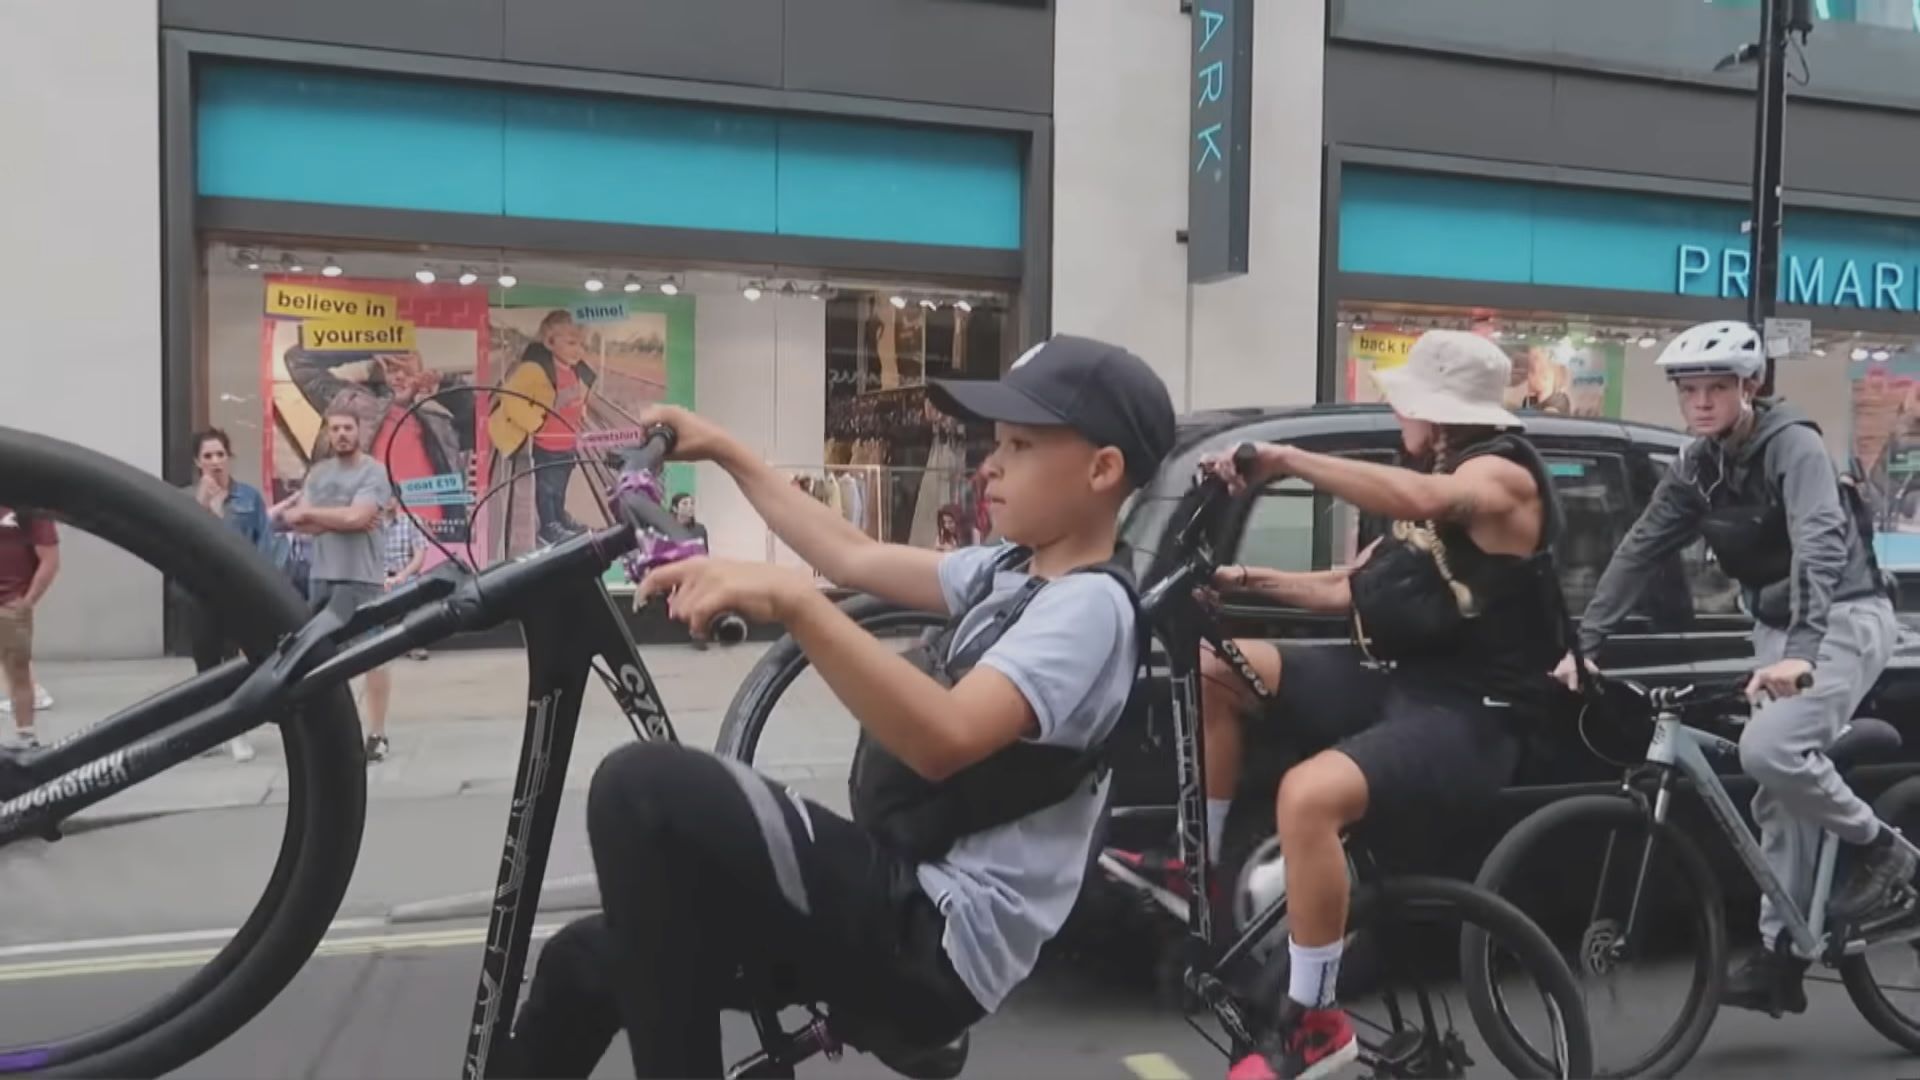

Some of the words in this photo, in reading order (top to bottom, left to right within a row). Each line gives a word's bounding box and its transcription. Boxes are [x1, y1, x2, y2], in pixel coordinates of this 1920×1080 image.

[1678, 244, 1920, 311] PRMAR
[278, 290, 358, 315] believe
[366, 297, 385, 318] in
[576, 304, 624, 319] shine!
[313, 325, 404, 347] yourself
[1360, 335, 1395, 353] back
